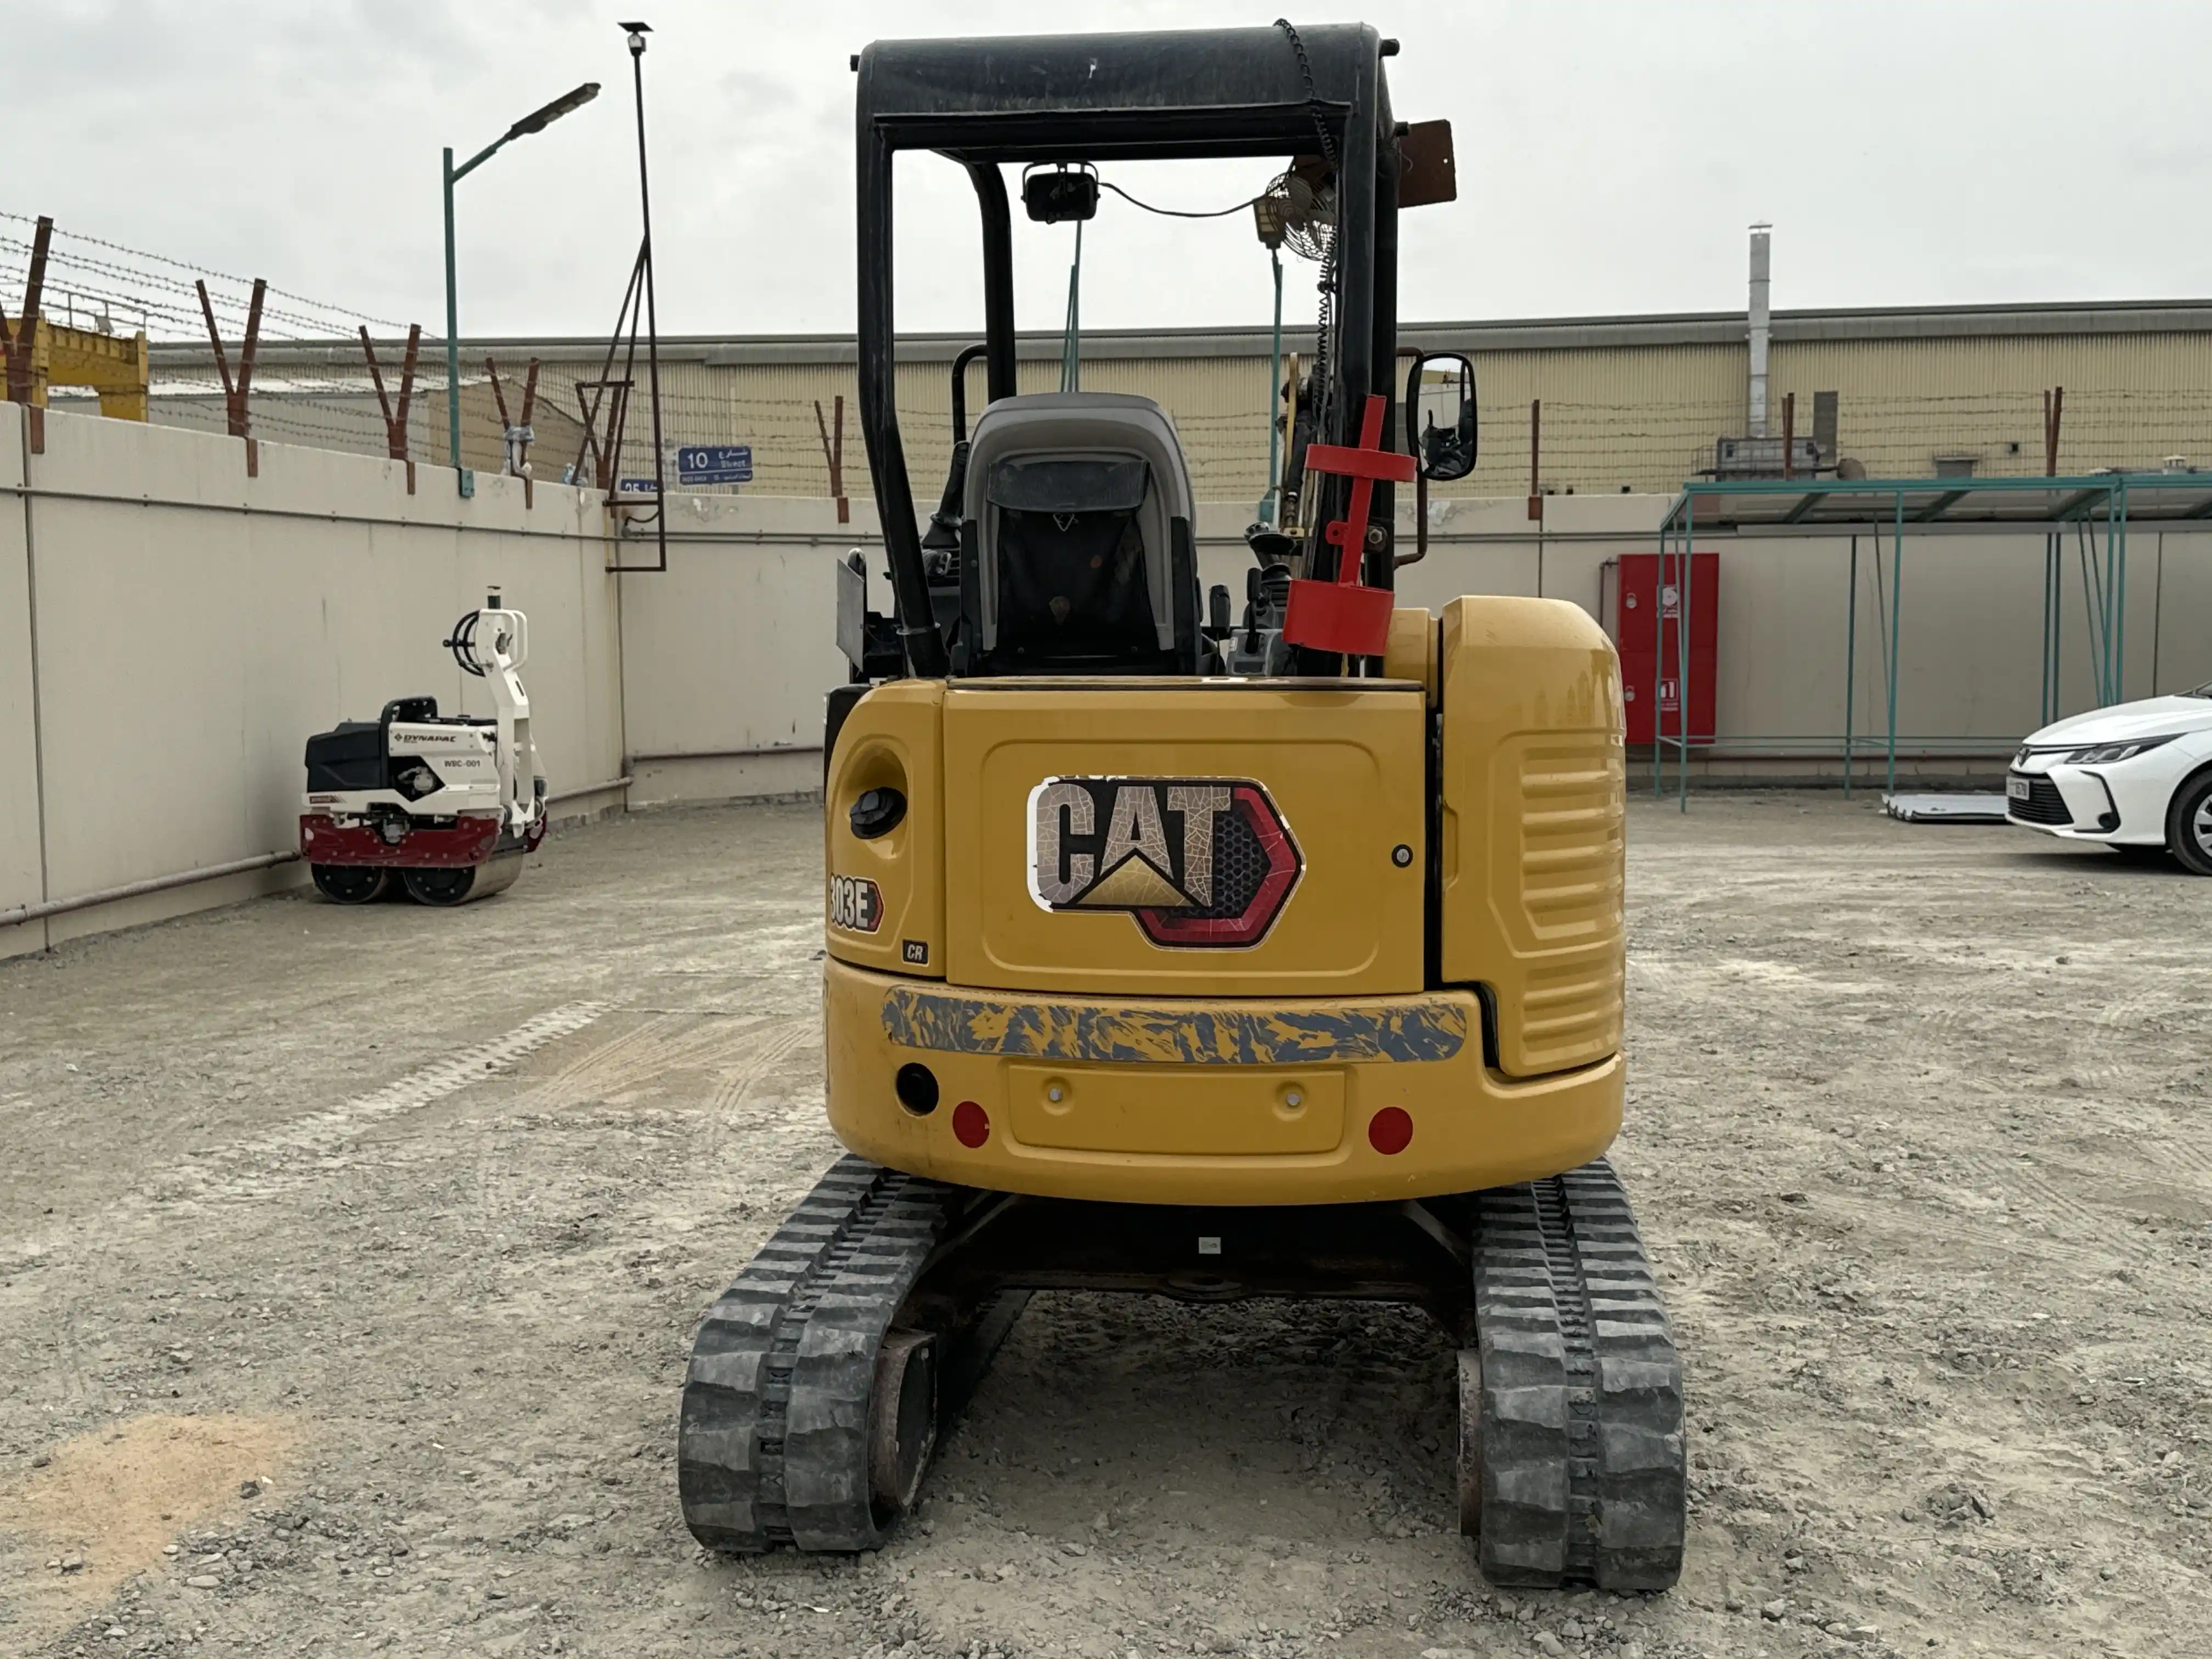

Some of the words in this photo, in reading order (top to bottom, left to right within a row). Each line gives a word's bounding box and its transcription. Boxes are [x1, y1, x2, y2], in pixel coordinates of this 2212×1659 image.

[687, 452, 708, 469] 10
[1036, 783, 1231, 908] CAT
[831, 874, 868, 927] 303E
[907, 944, 923, 960] CR
